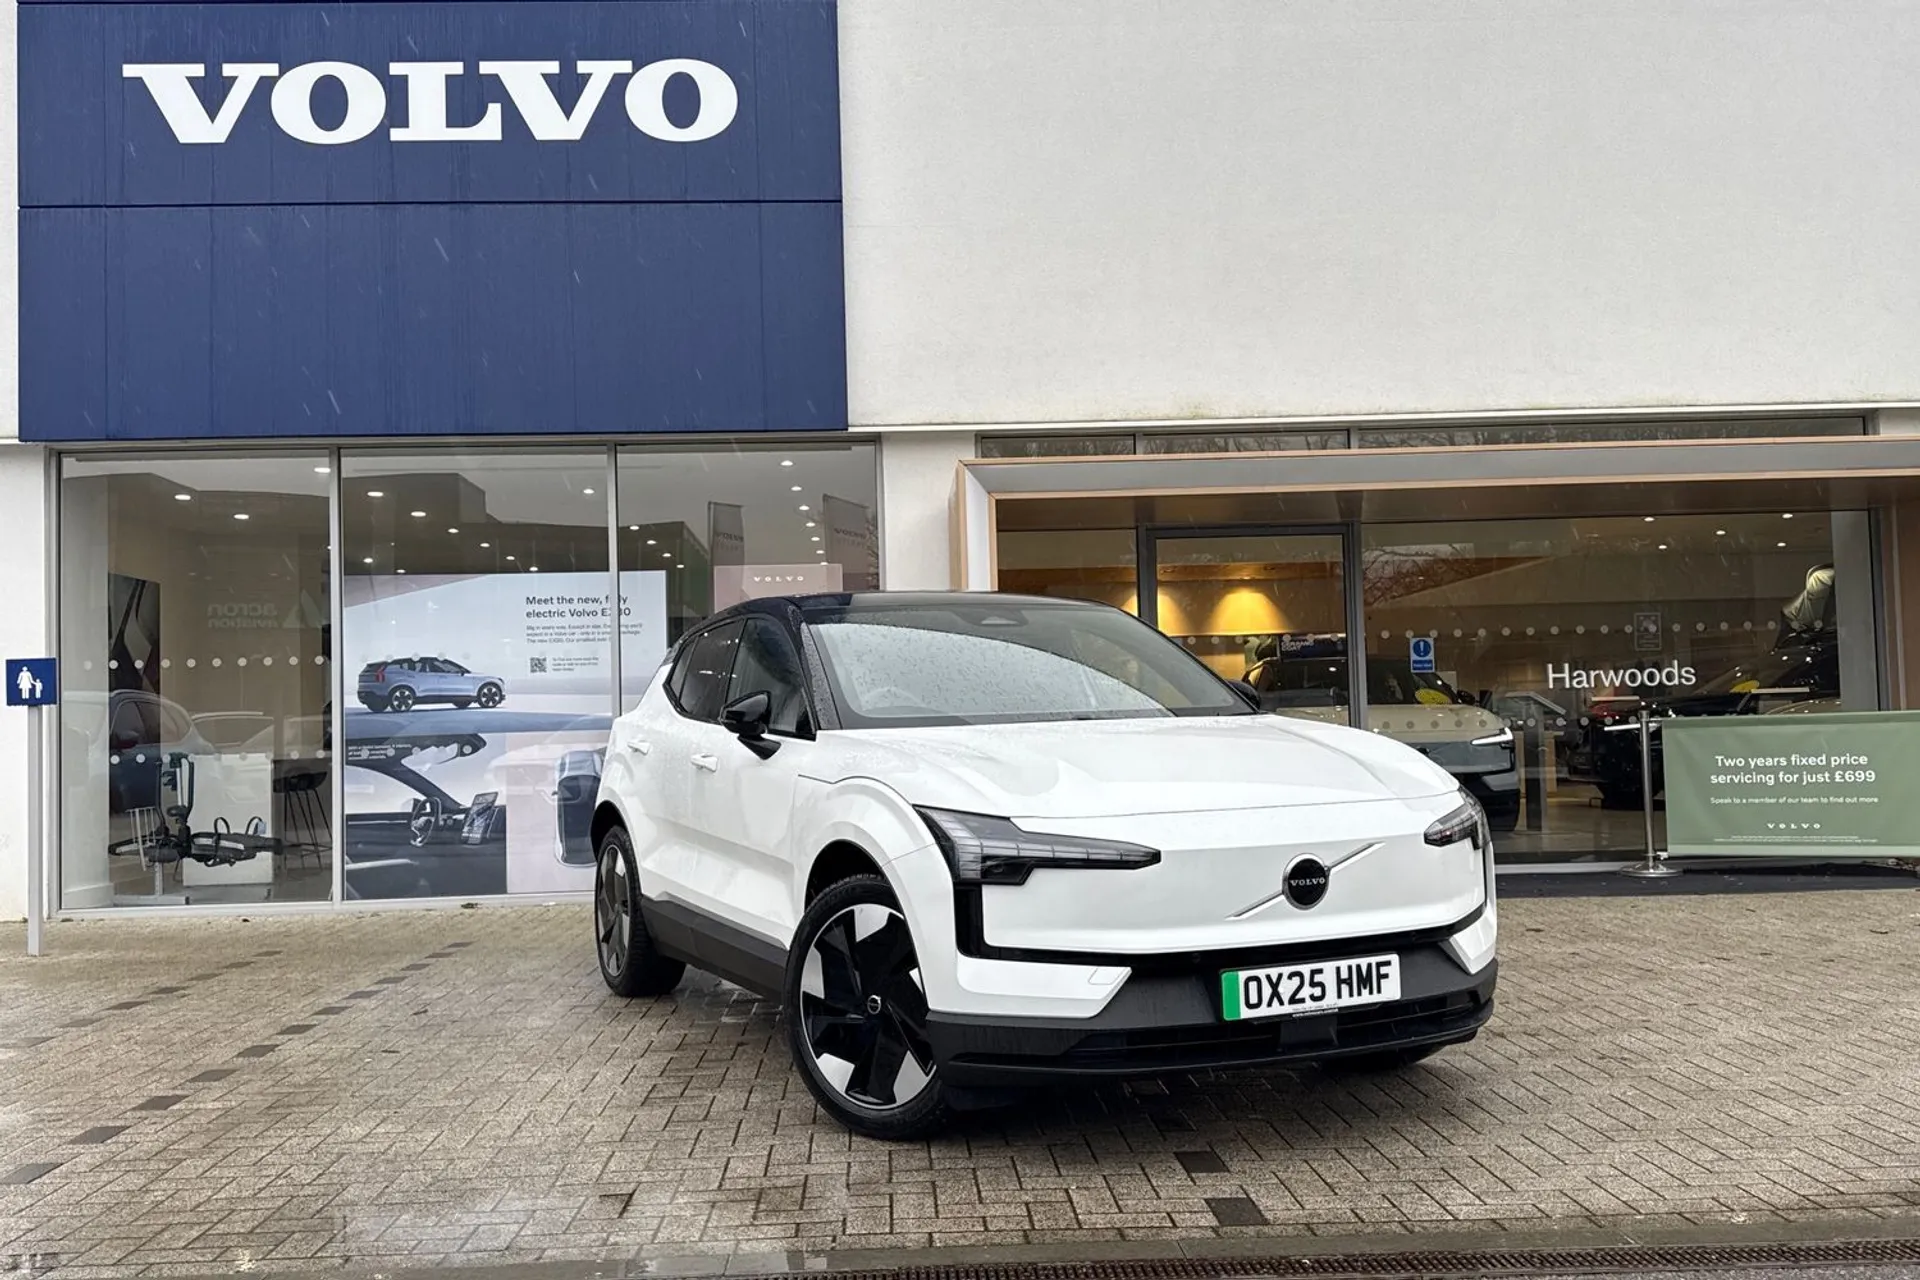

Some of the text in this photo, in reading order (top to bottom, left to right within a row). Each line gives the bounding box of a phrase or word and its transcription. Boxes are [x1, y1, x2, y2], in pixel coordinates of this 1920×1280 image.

[122, 58, 739, 145] VOLVO
[753, 575, 804, 583] VOLVO
[526, 596, 554, 605] Meet
[556, 595, 574, 604] the
[577, 596, 602, 605] new,
[526, 607, 631, 618] electric Volvo E30
[1547, 659, 1697, 689] Harwoods
[1715, 753, 1868, 769] Two years fixed price
[1710, 770, 1876, 786] servicing for just £699
[1710, 797, 1732, 805] Speak
[1779, 796, 1787, 804] of
[1766, 822, 1821, 830] VOLVO
[1289, 877, 1326, 887] VOLVO
[1244, 960, 1392, 1010] OX25 HMF
